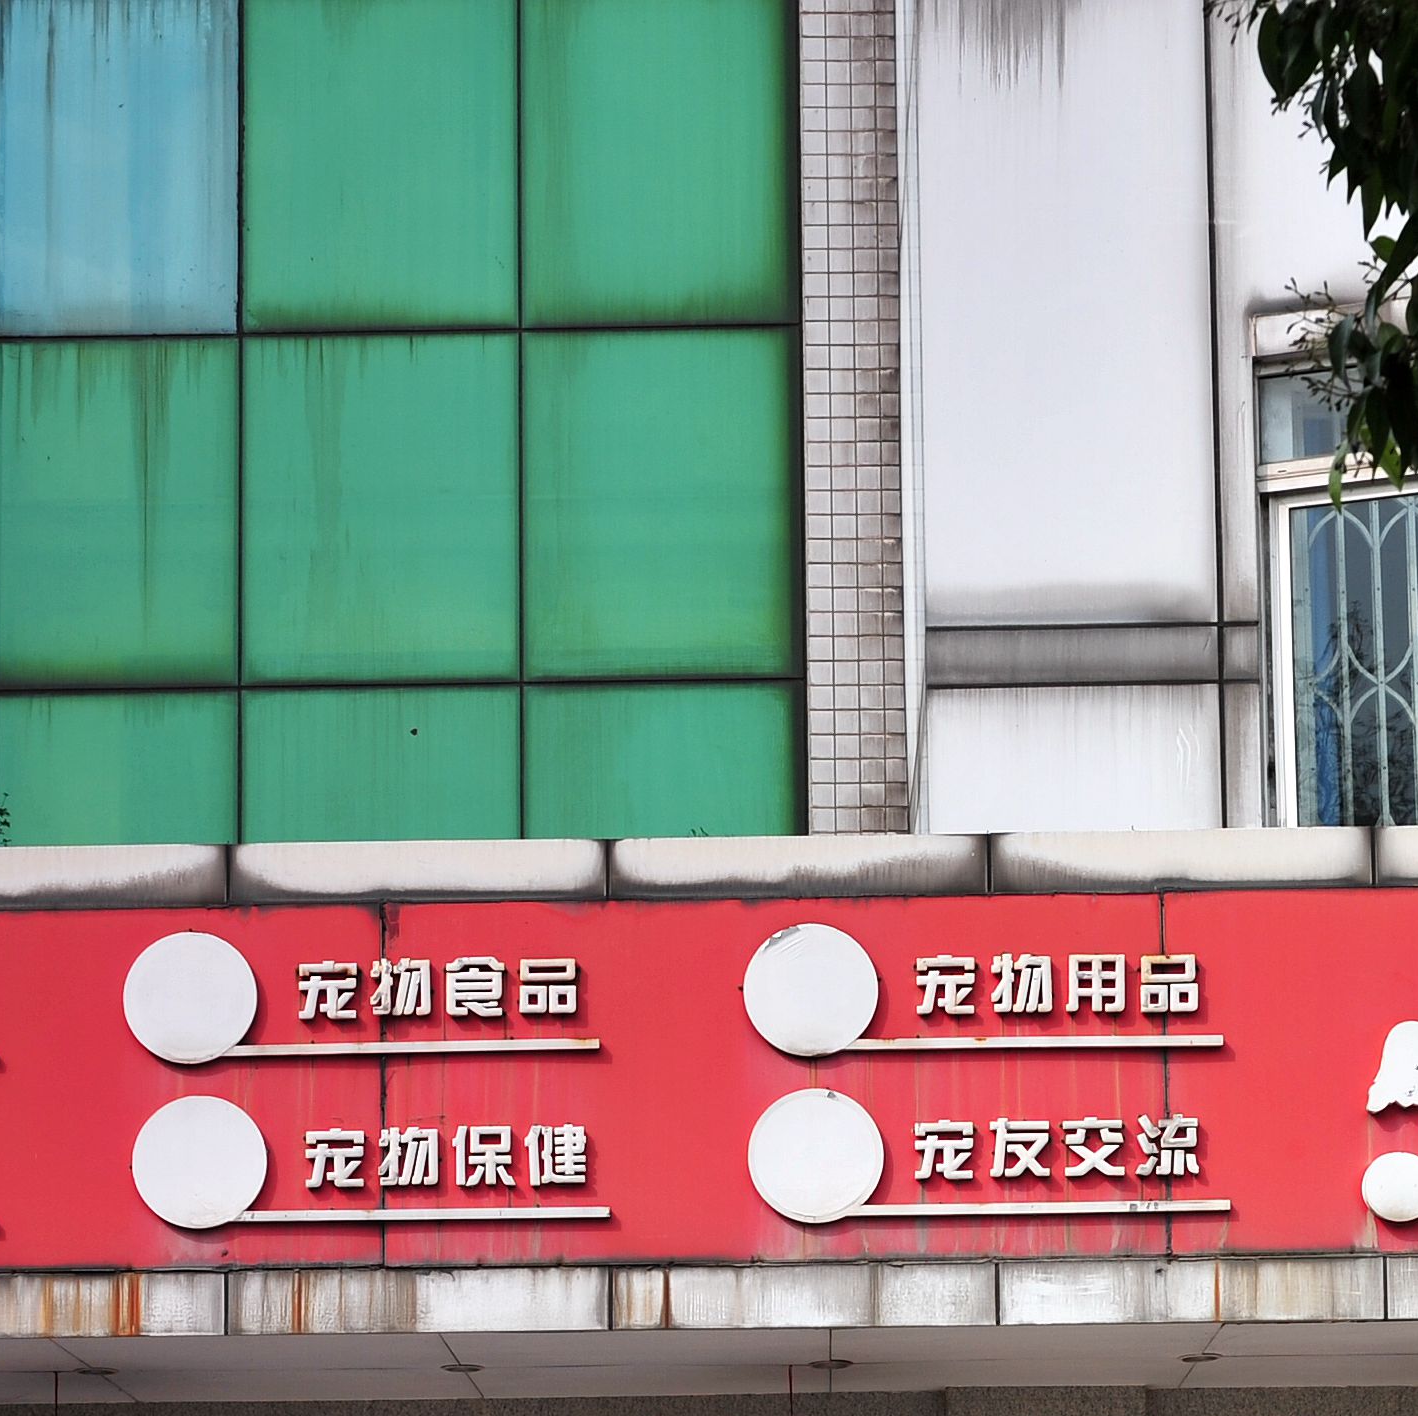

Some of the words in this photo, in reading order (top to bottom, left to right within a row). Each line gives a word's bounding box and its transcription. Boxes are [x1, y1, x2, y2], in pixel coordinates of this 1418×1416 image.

[297, 955, 578, 1020] 宠物食品
[915, 952, 1200, 1016] 宠物用品
[304, 1123, 588, 1189] 宠物保健
[913, 1113, 1201, 1182] 宠友交流
